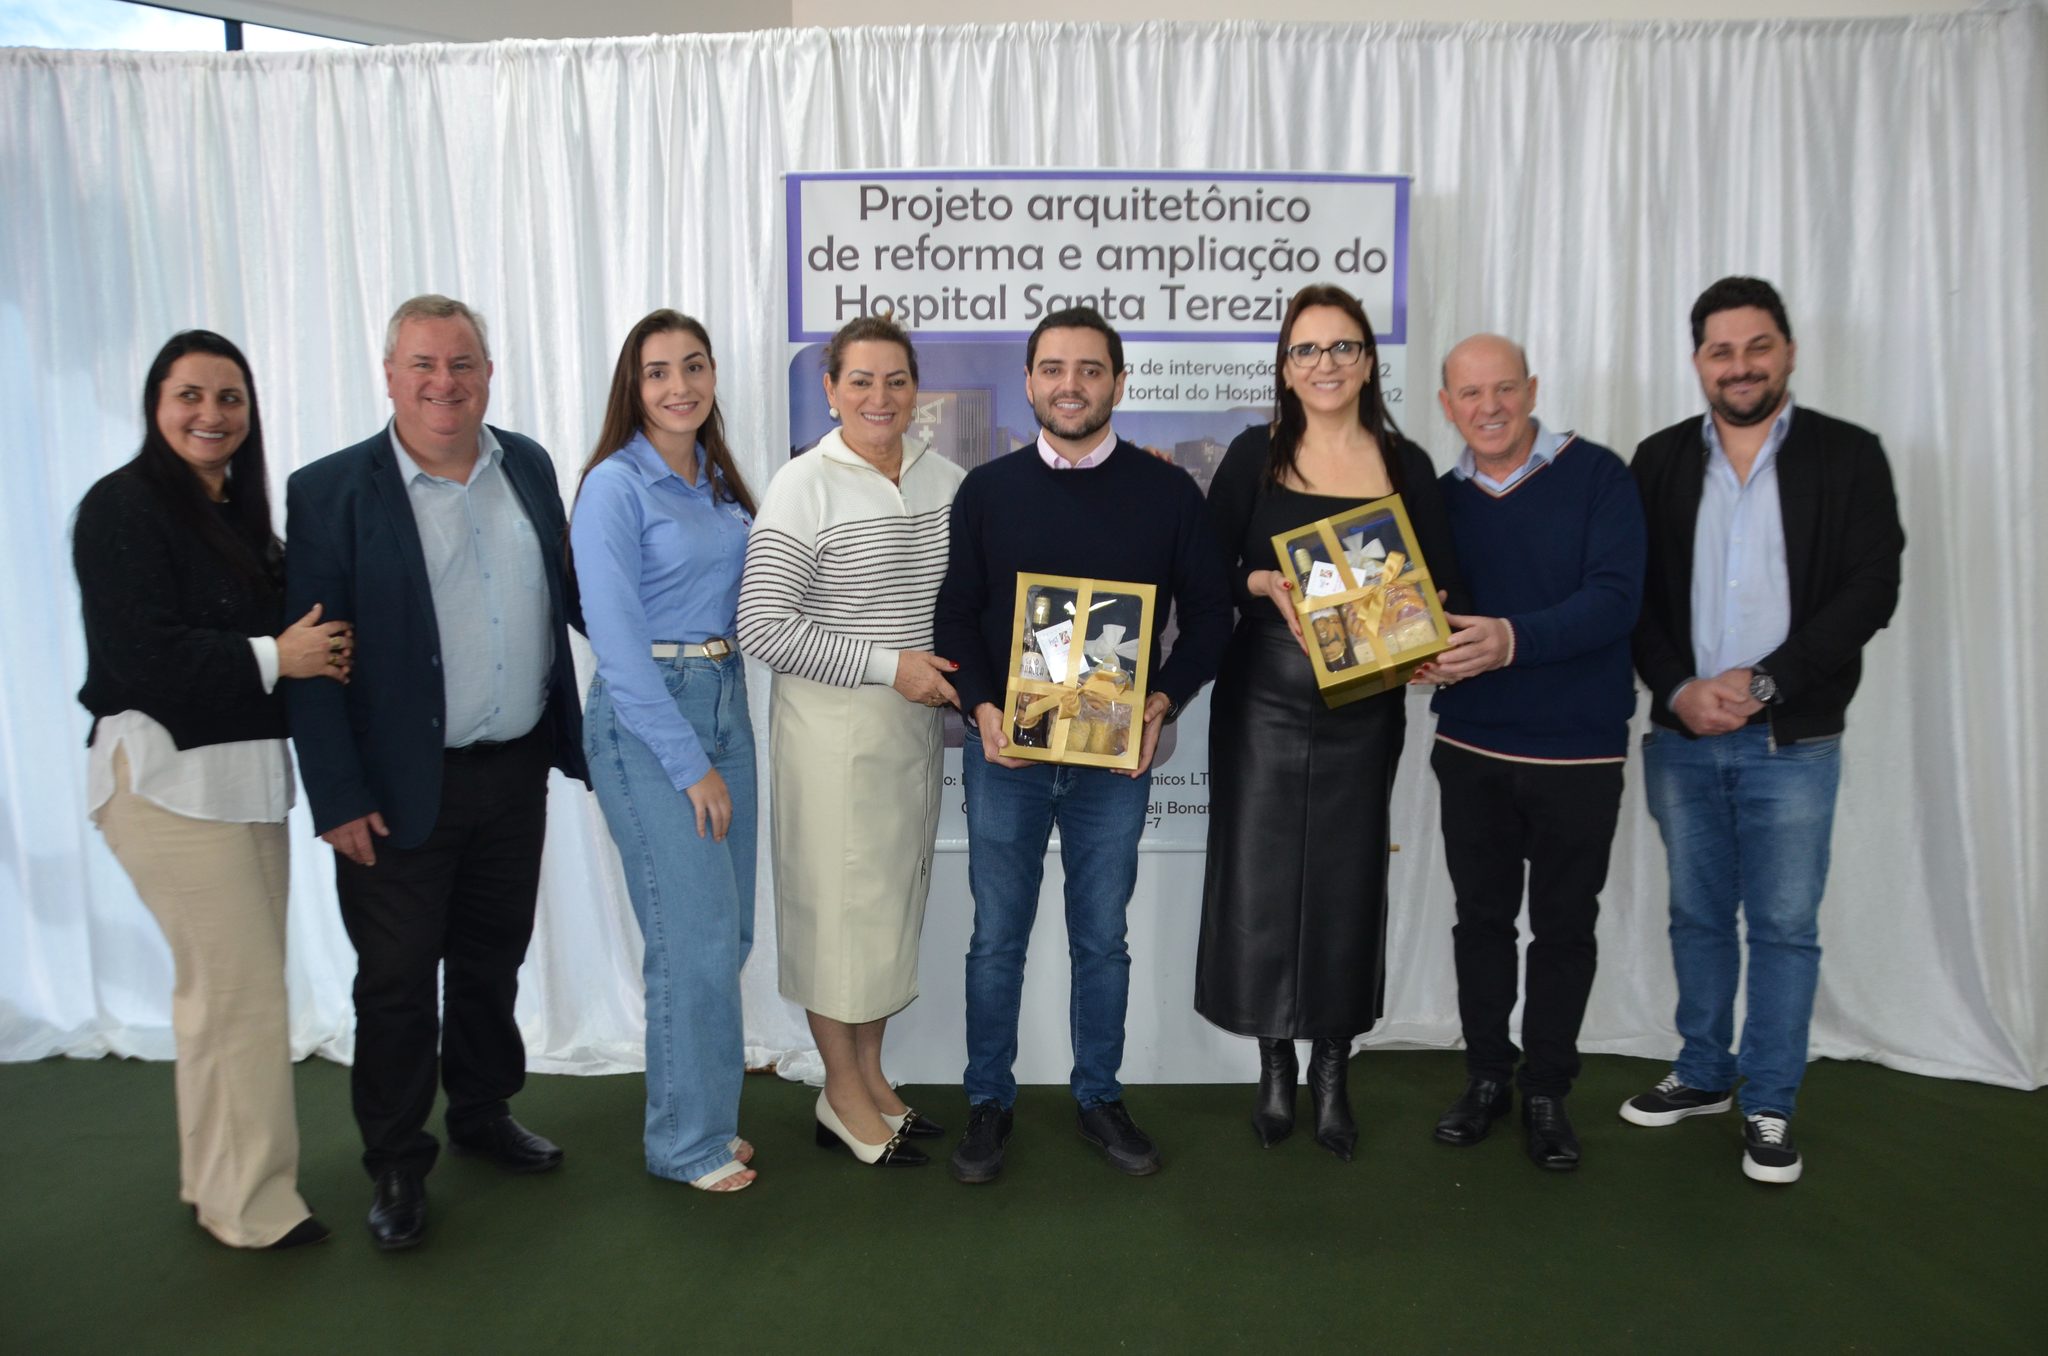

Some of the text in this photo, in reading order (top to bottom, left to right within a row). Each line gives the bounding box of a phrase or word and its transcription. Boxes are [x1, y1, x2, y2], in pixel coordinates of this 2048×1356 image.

[859, 184, 1311, 229] Projeto arquitetônico
[807, 232, 1387, 281] de reforma e ampliação do
[834, 283, 1007, 328] Hospital
[1159, 282, 1362, 321] Terezi
[1140, 358, 1164, 375] de
[1128, 383, 1179, 400] tortal
[1185, 383, 1209, 400] do
[1215, 383, 1276, 404] Hospit
